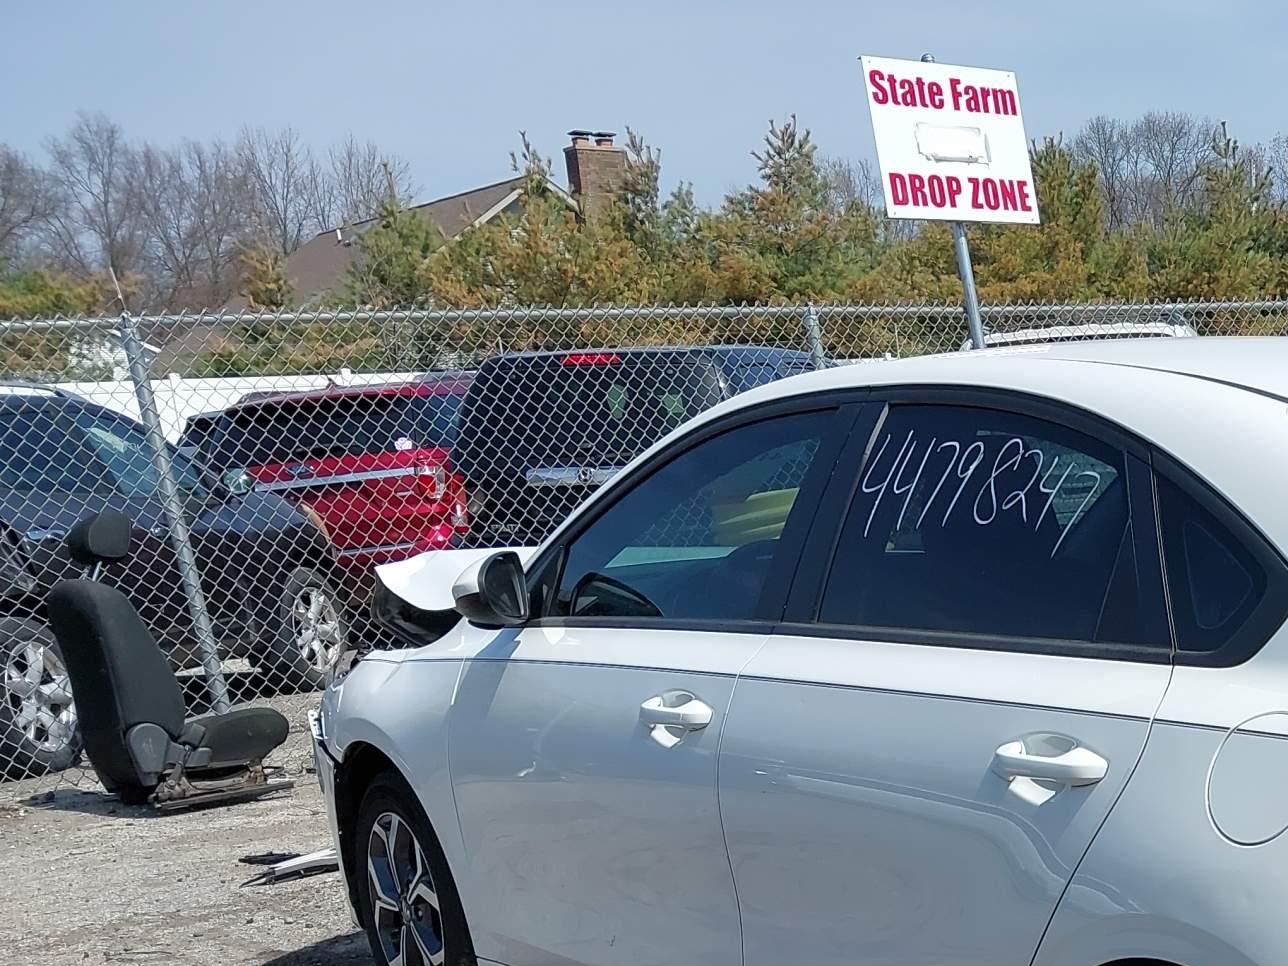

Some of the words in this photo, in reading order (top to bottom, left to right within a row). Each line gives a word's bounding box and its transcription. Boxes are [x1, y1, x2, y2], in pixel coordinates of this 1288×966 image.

[869, 69, 945, 109] State
[949, 78, 1018, 117] Farm
[888, 172, 962, 209] DROP
[968, 177, 1032, 212] ZONE
[861, 429, 1101, 559] 44798247
